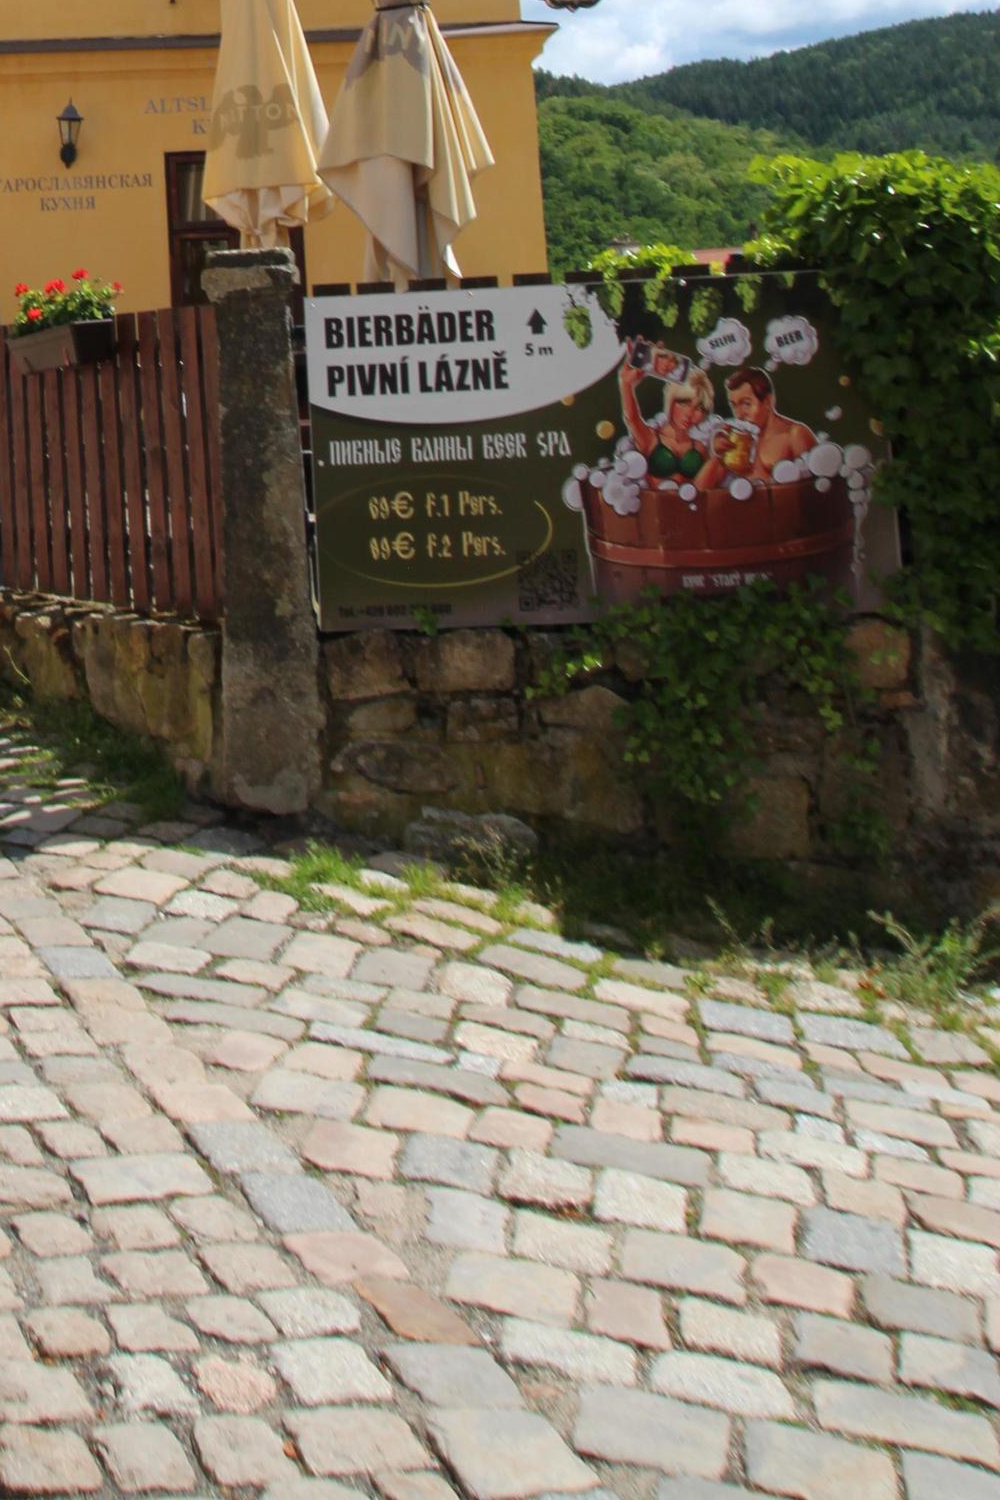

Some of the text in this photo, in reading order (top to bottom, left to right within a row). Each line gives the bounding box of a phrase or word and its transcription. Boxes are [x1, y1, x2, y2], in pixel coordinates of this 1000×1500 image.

[40, 195, 96, 212] КУХНЯ
[324, 306, 495, 349] BIERBÄDER
[775, 329, 804, 347] BEER
[524, 343, 553, 356] 5 m
[326, 351, 509, 397] PIVNÍ LÁZNĚ
[537, 431, 572, 457] SPA
[368, 490, 415, 520] 69€
[458, 490, 503, 517] Pers.
[462, 531, 507, 558] Pers.
